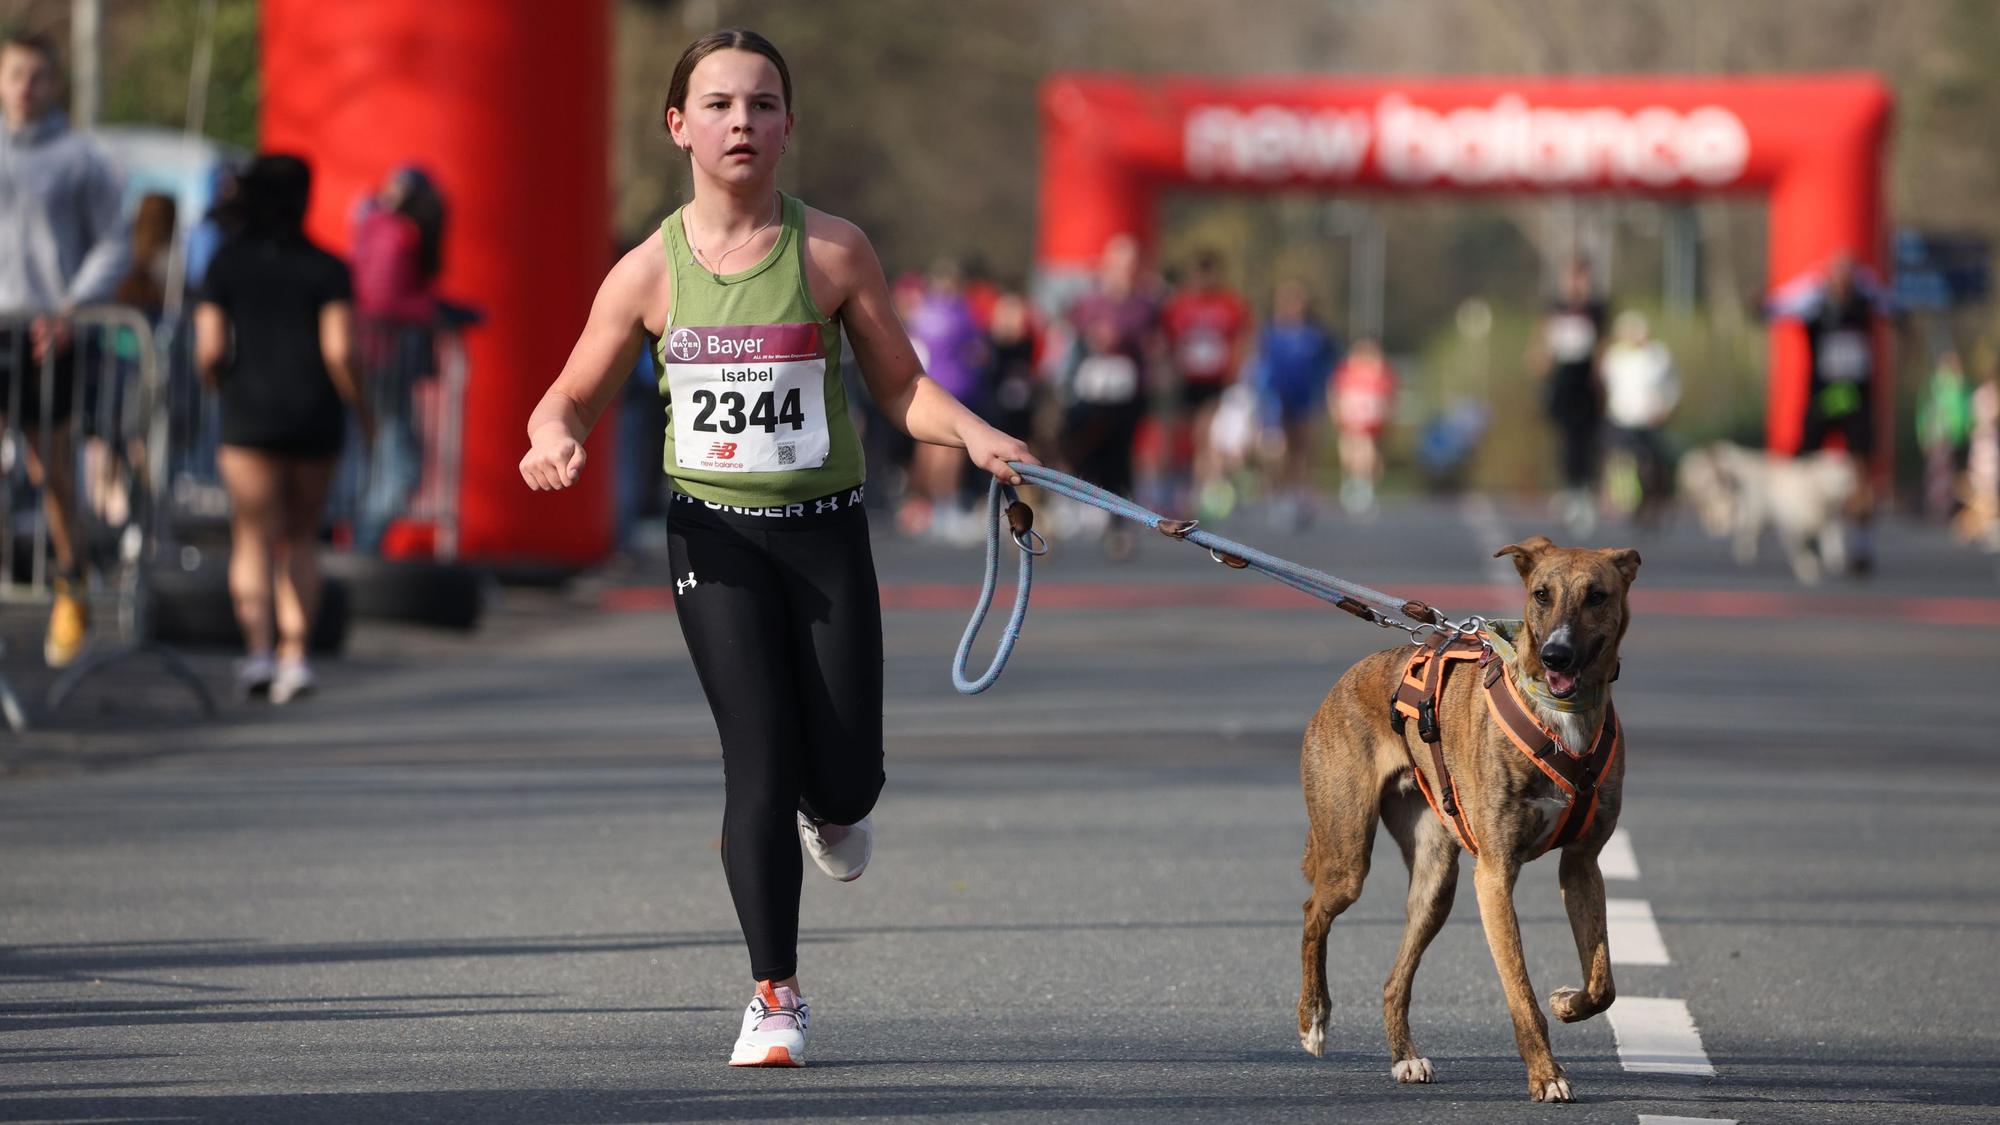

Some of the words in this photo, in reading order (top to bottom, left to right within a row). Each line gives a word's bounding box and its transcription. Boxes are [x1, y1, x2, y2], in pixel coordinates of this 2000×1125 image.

[1184, 103, 1371, 181] new
[1375, 92, 1750, 186] balance
[707, 335, 764, 358] Bayer
[721, 367, 773, 382] Isabel
[692, 388, 805, 434] 2344
[714, 460, 744, 468] balance
